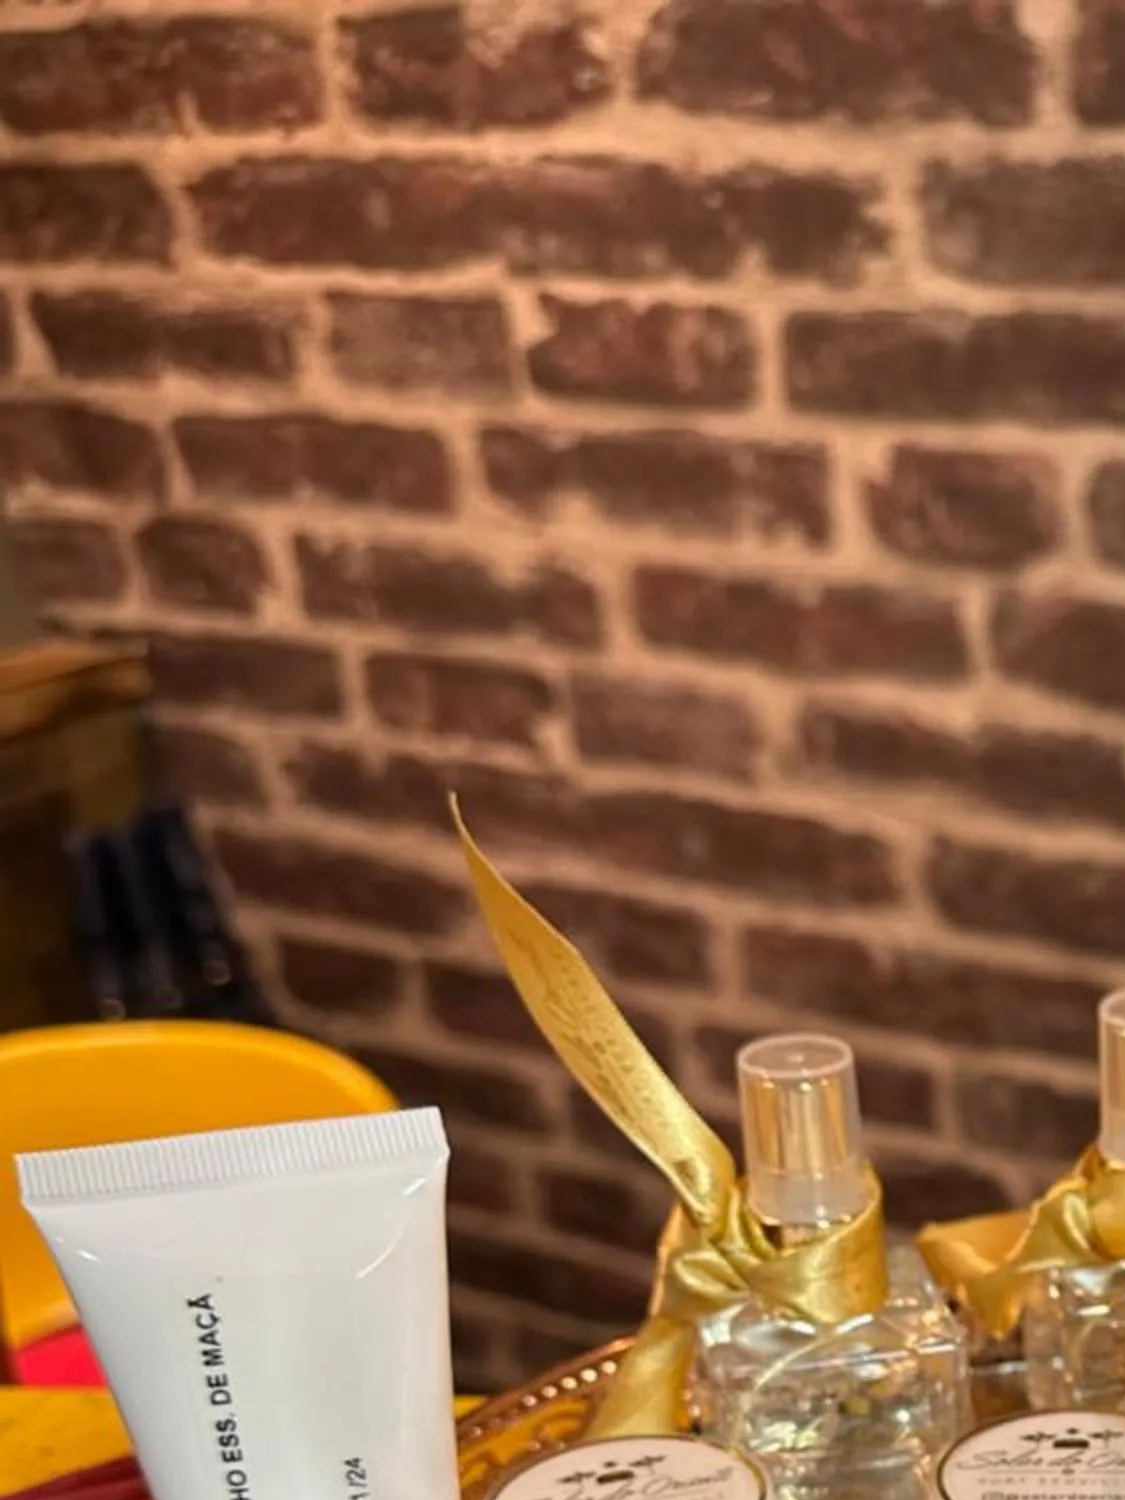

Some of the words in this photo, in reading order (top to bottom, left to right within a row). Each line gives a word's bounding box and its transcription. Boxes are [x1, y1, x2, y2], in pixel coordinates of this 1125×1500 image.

[187, 1293, 225, 1367] MAÇÃ
[206, 1373, 232, 1406] DE
[215, 1412, 243, 1463] ESS.
